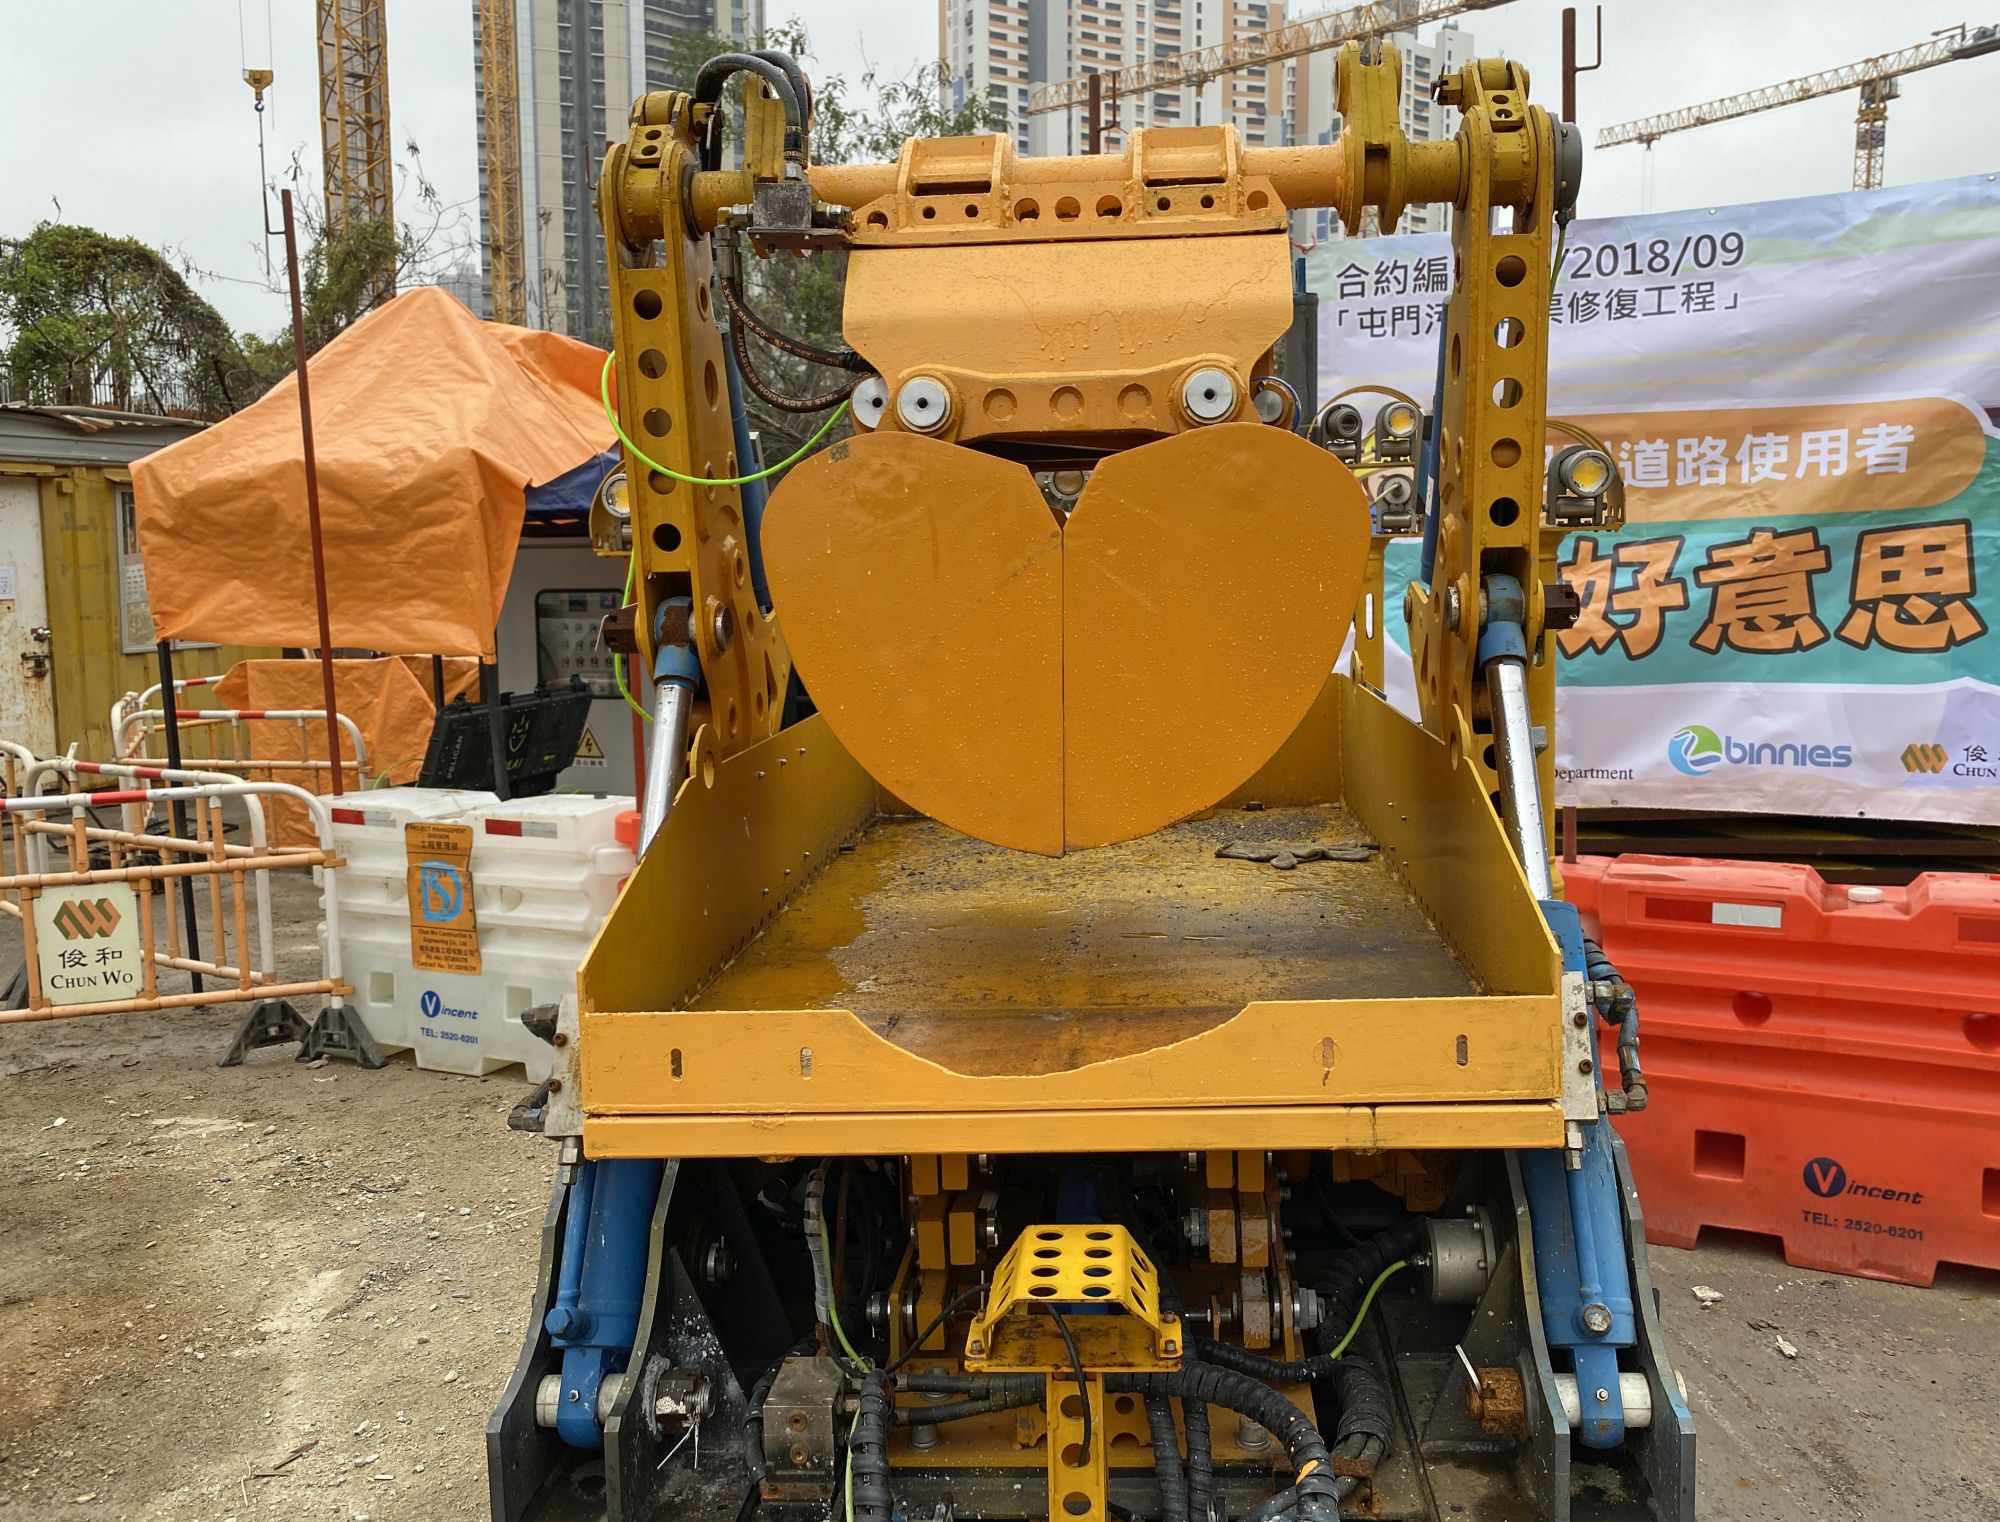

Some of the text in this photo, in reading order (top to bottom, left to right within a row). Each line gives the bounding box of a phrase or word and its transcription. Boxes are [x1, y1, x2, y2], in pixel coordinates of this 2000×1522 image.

[1556, 518, 1988, 661] 好意思
[1725, 735, 1853, 768] binnies
[58, 946, 123, 970] 俊和
[50, 974, 98, 990] CHUN
[421, 990, 479, 1020] Vincent
[420, 1026, 479, 1044] TEL: 2520-6201
[1803, 1157, 1924, 1205] Vincent
[1802, 1209, 1924, 1241] TEL: 2520-6201
